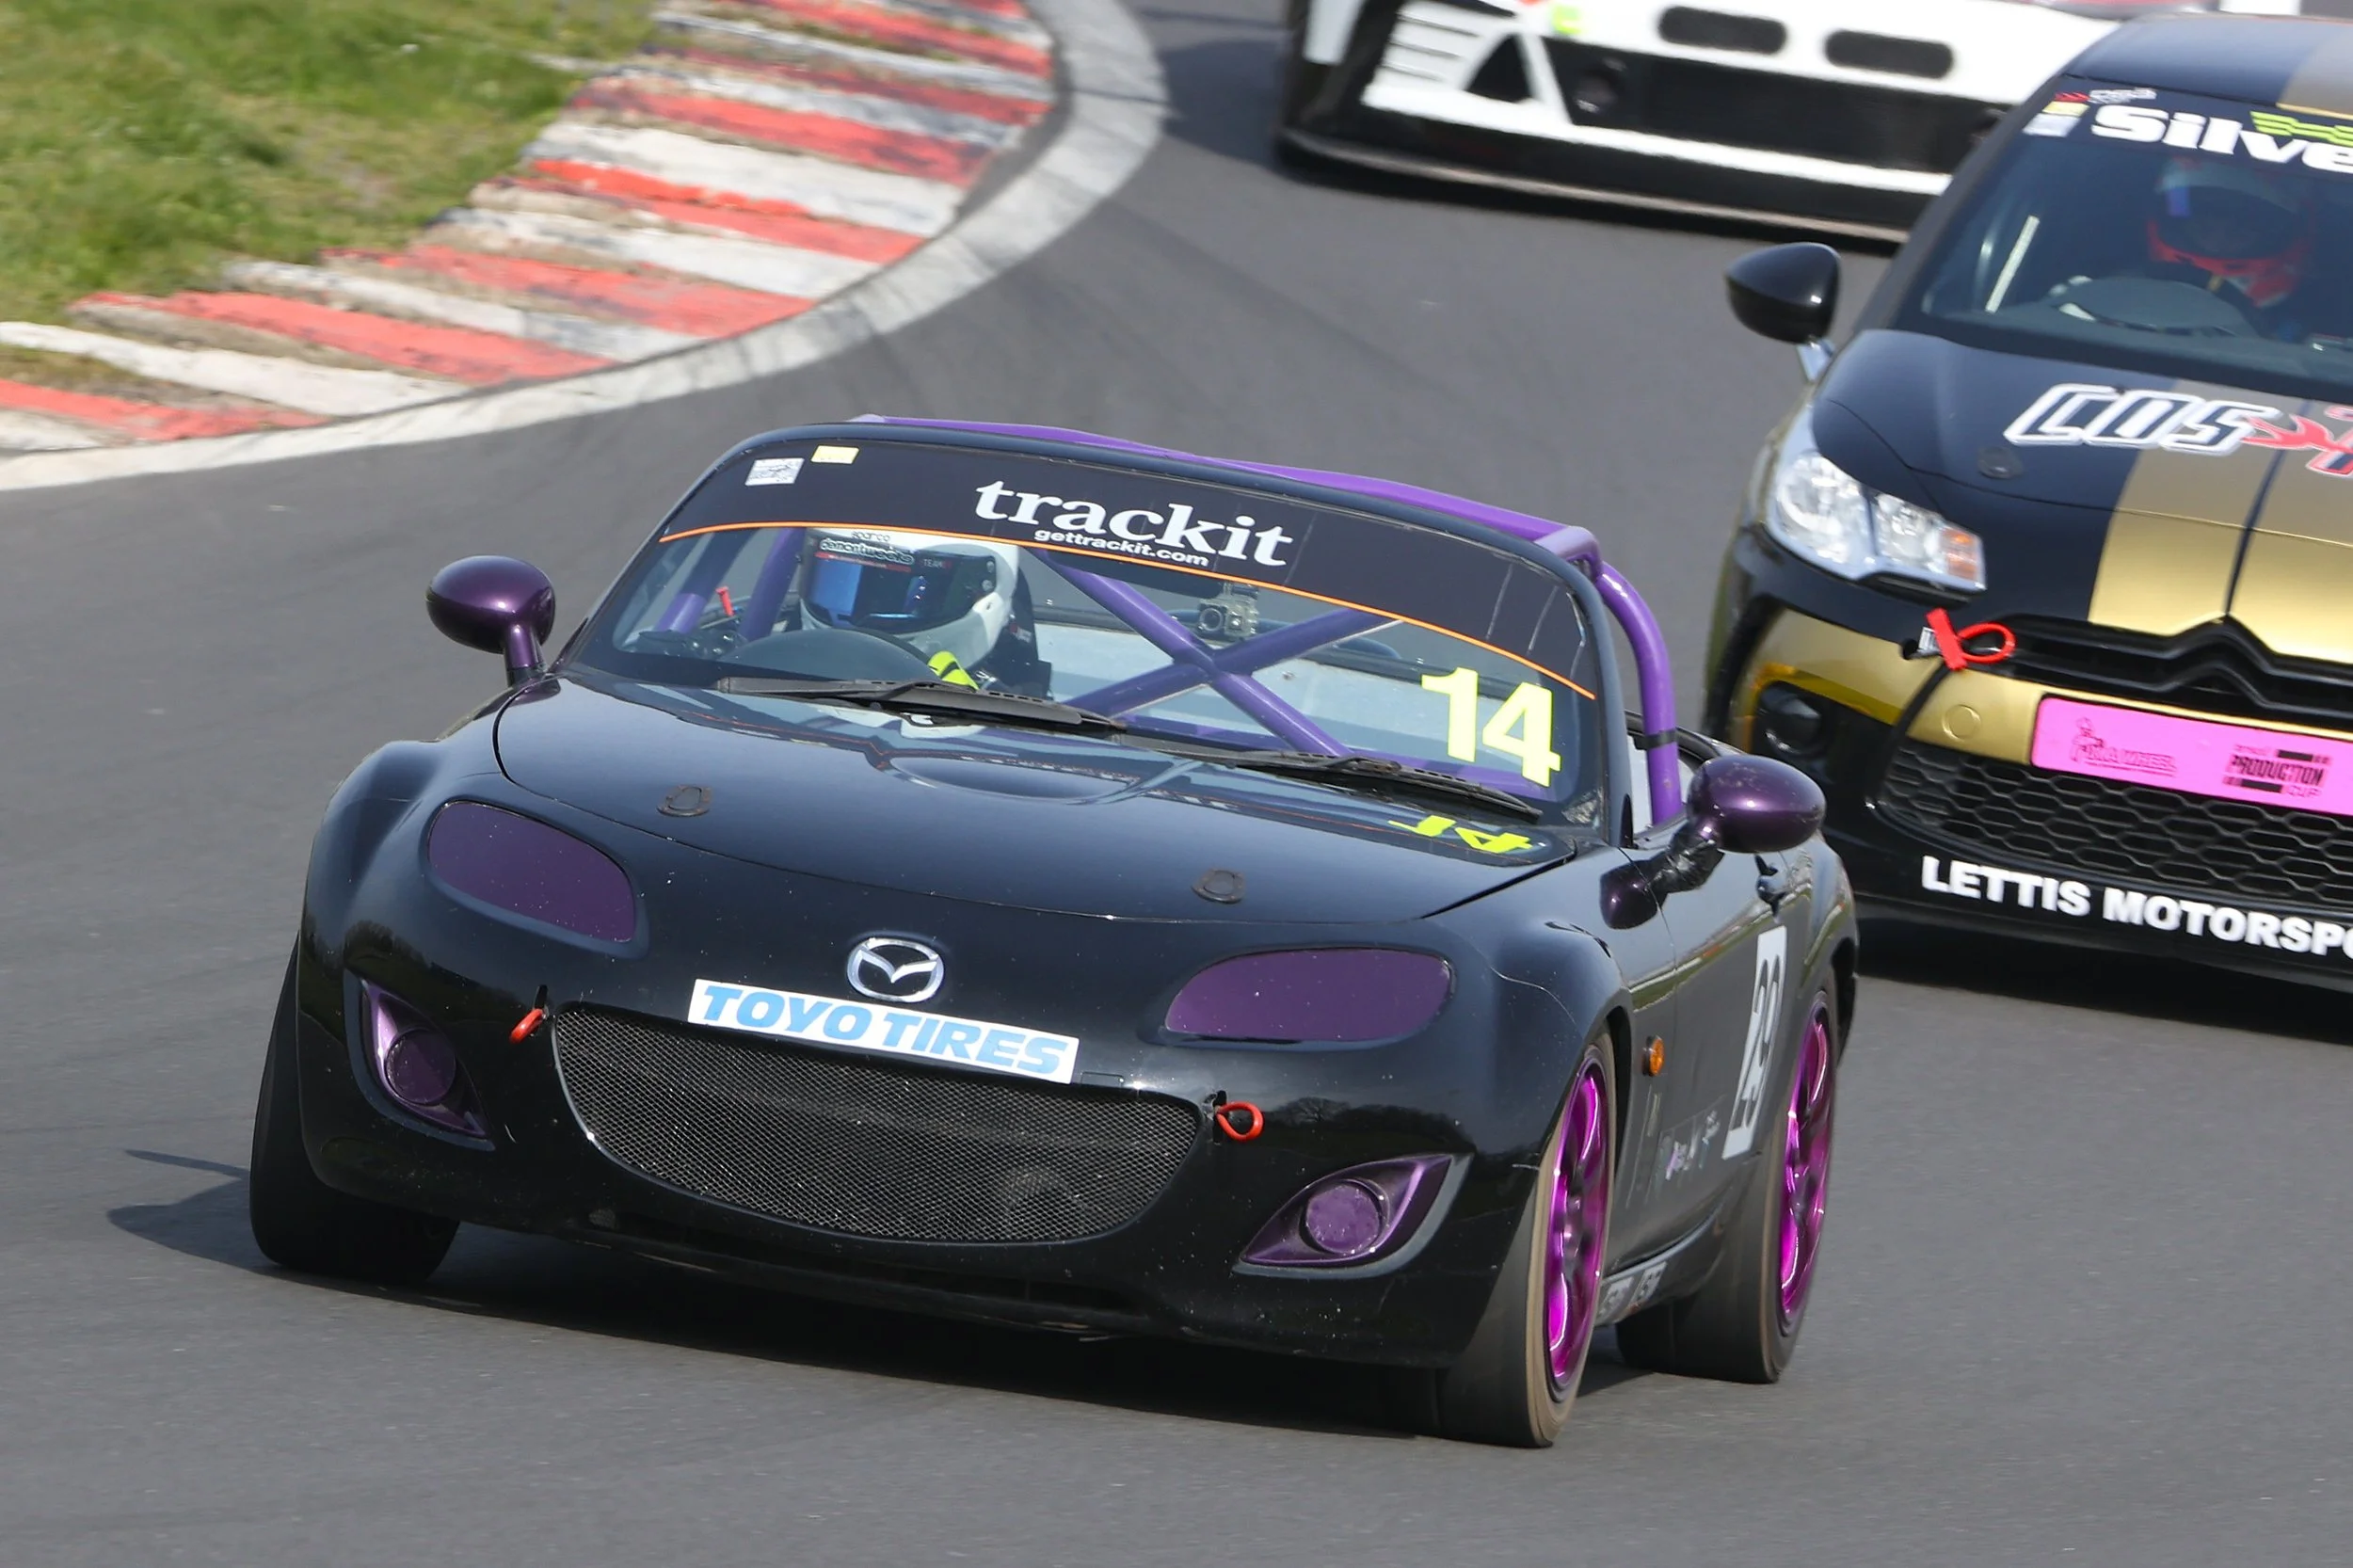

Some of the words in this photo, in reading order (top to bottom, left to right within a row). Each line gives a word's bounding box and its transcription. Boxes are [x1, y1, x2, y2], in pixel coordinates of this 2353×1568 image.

[975, 480, 1293, 566] trackit
[1034, 530, 1209, 567] gettrackit.com
[1421, 666, 1561, 787] 14
[2229, 754, 2324, 786] PRODUCTION
[1921, 856, 2090, 917] LETTIS
[2102, 887, 2353, 957] MOTORSP
[704, 985, 872, 1041] TOYO
[883, 1013, 1068, 1074] TIRES
